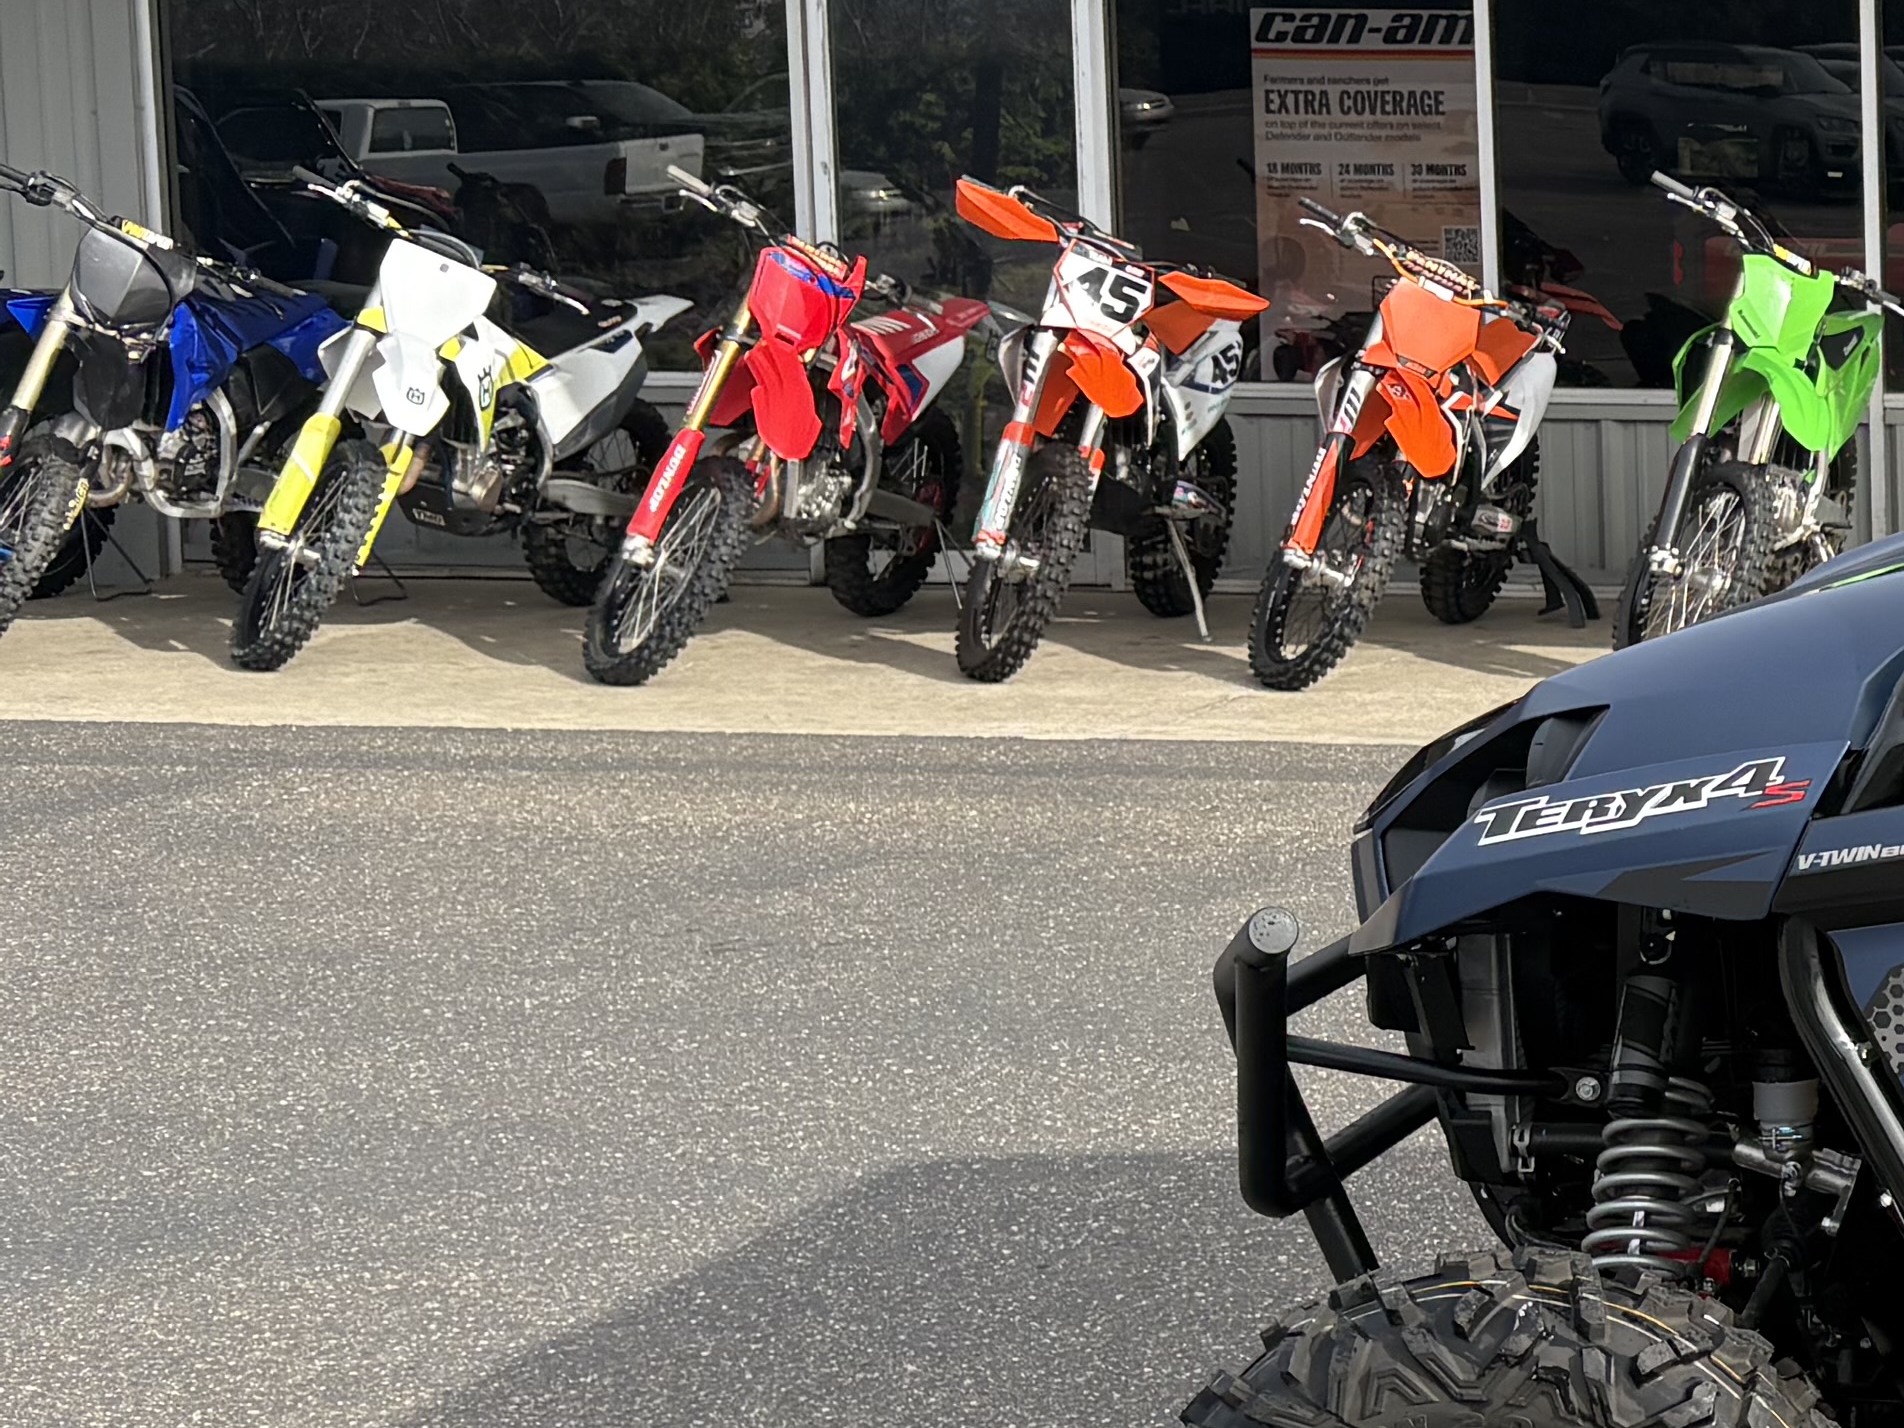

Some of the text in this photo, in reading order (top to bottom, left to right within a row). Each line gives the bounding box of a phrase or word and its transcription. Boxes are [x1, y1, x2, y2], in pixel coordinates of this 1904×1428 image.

[1264, 89, 1446, 116] EXTRA COVERAGE
[1076, 266, 1149, 324] 45
